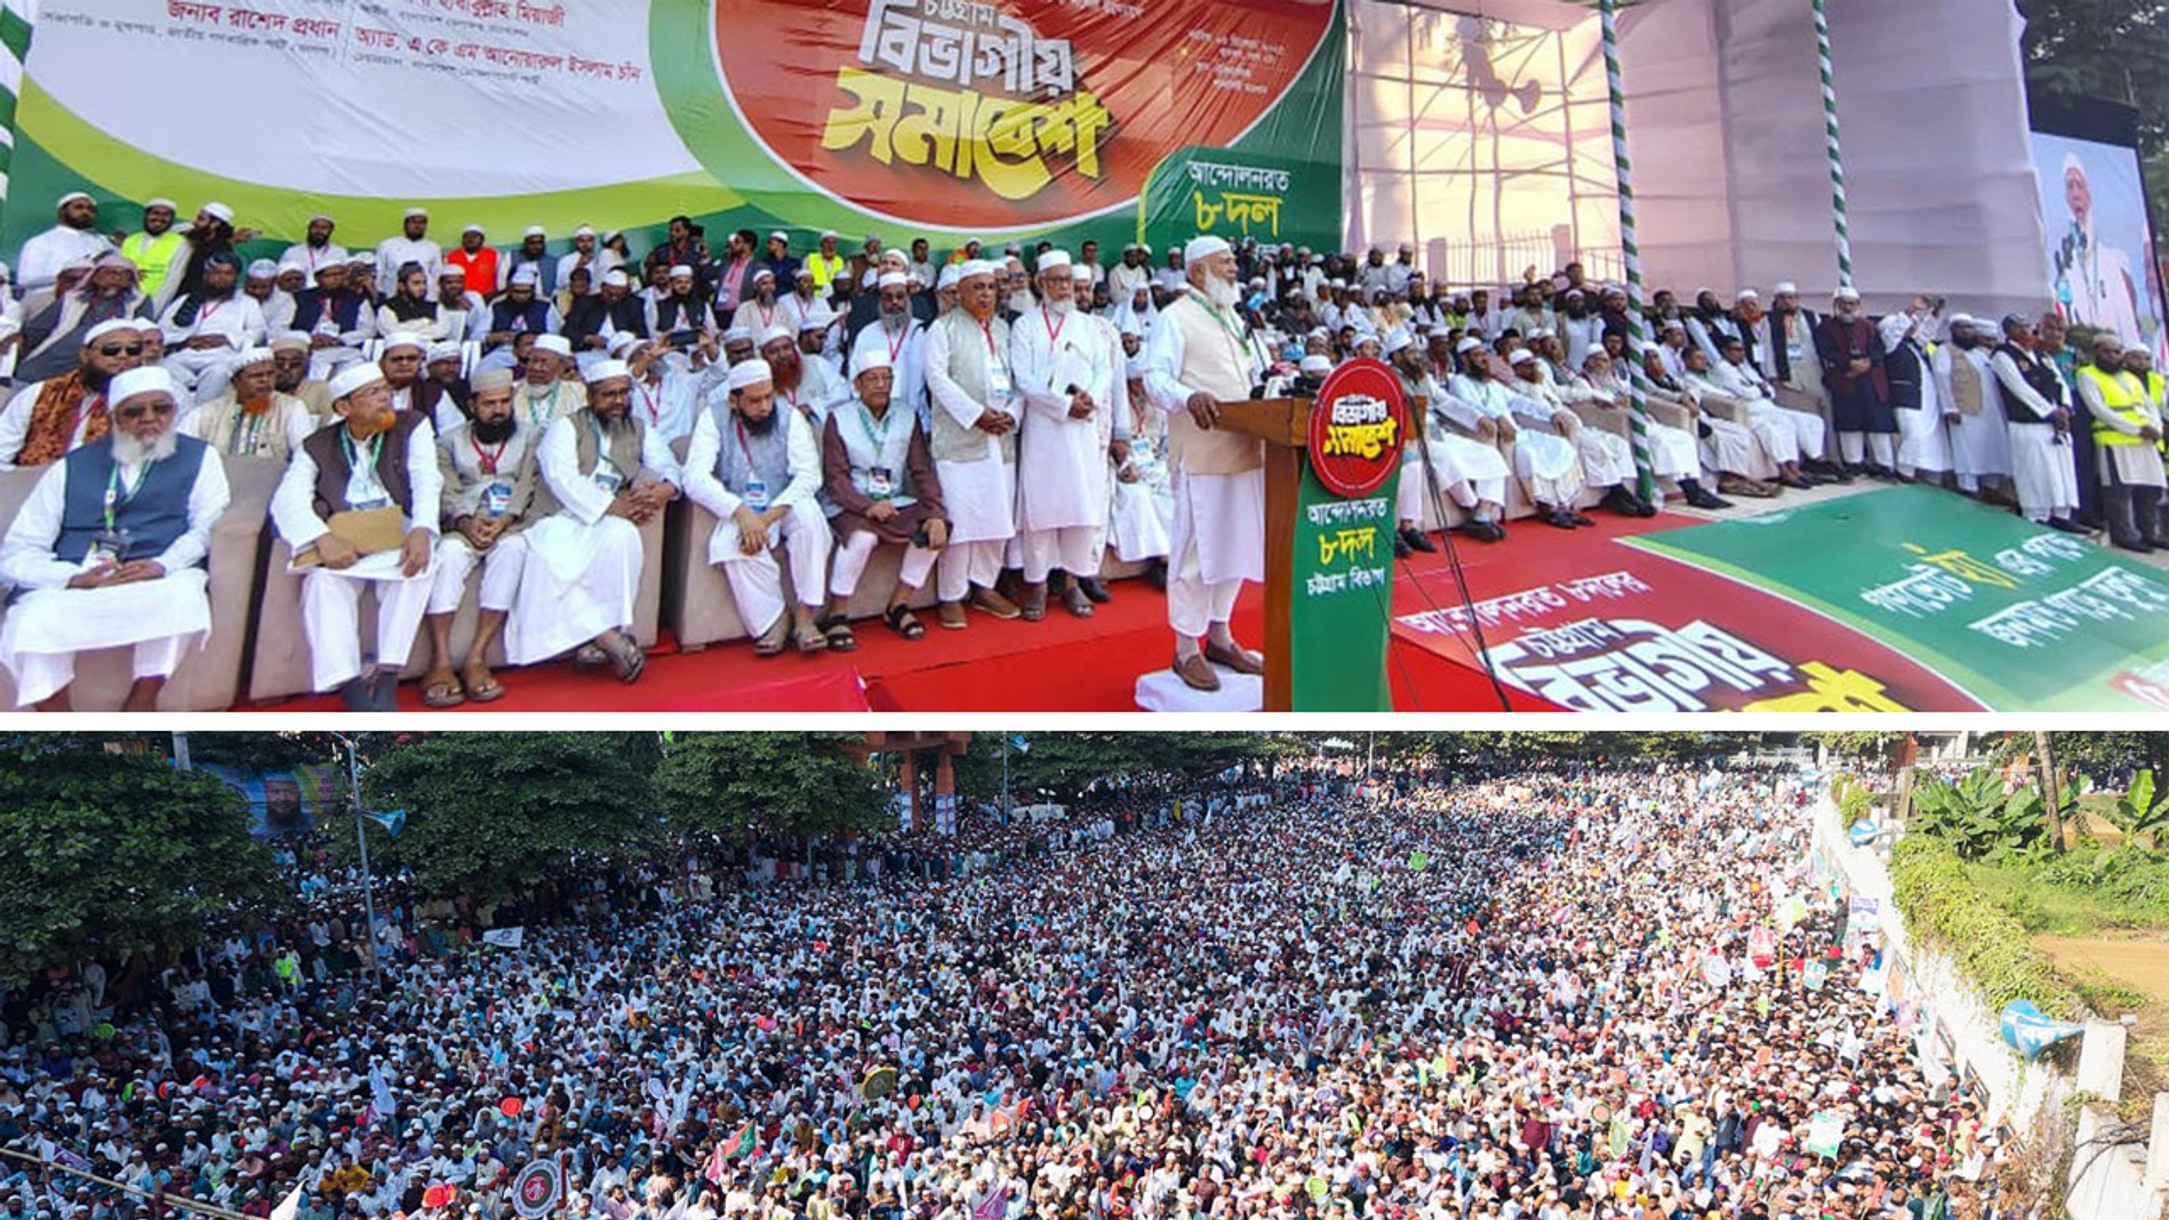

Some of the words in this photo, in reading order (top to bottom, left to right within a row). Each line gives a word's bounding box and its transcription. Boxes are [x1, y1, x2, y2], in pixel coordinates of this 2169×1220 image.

[166, 0, 222, 25] জনাব
[228, 5, 290, 30] রাশেদ
[291, 17, 341, 40] প্রধান
[407, 37, 421, 52] এ
[427, 38, 449, 55] কে
[453, 43, 480, 60] এম
[858, 0, 1074, 97] বিভাগীয়
[820, 65, 1110, 200] সমাবেশ
[1187, 160, 1291, 191] আন্দোলনরত
[1307, 498, 1388, 527] আন্দোলনরত
